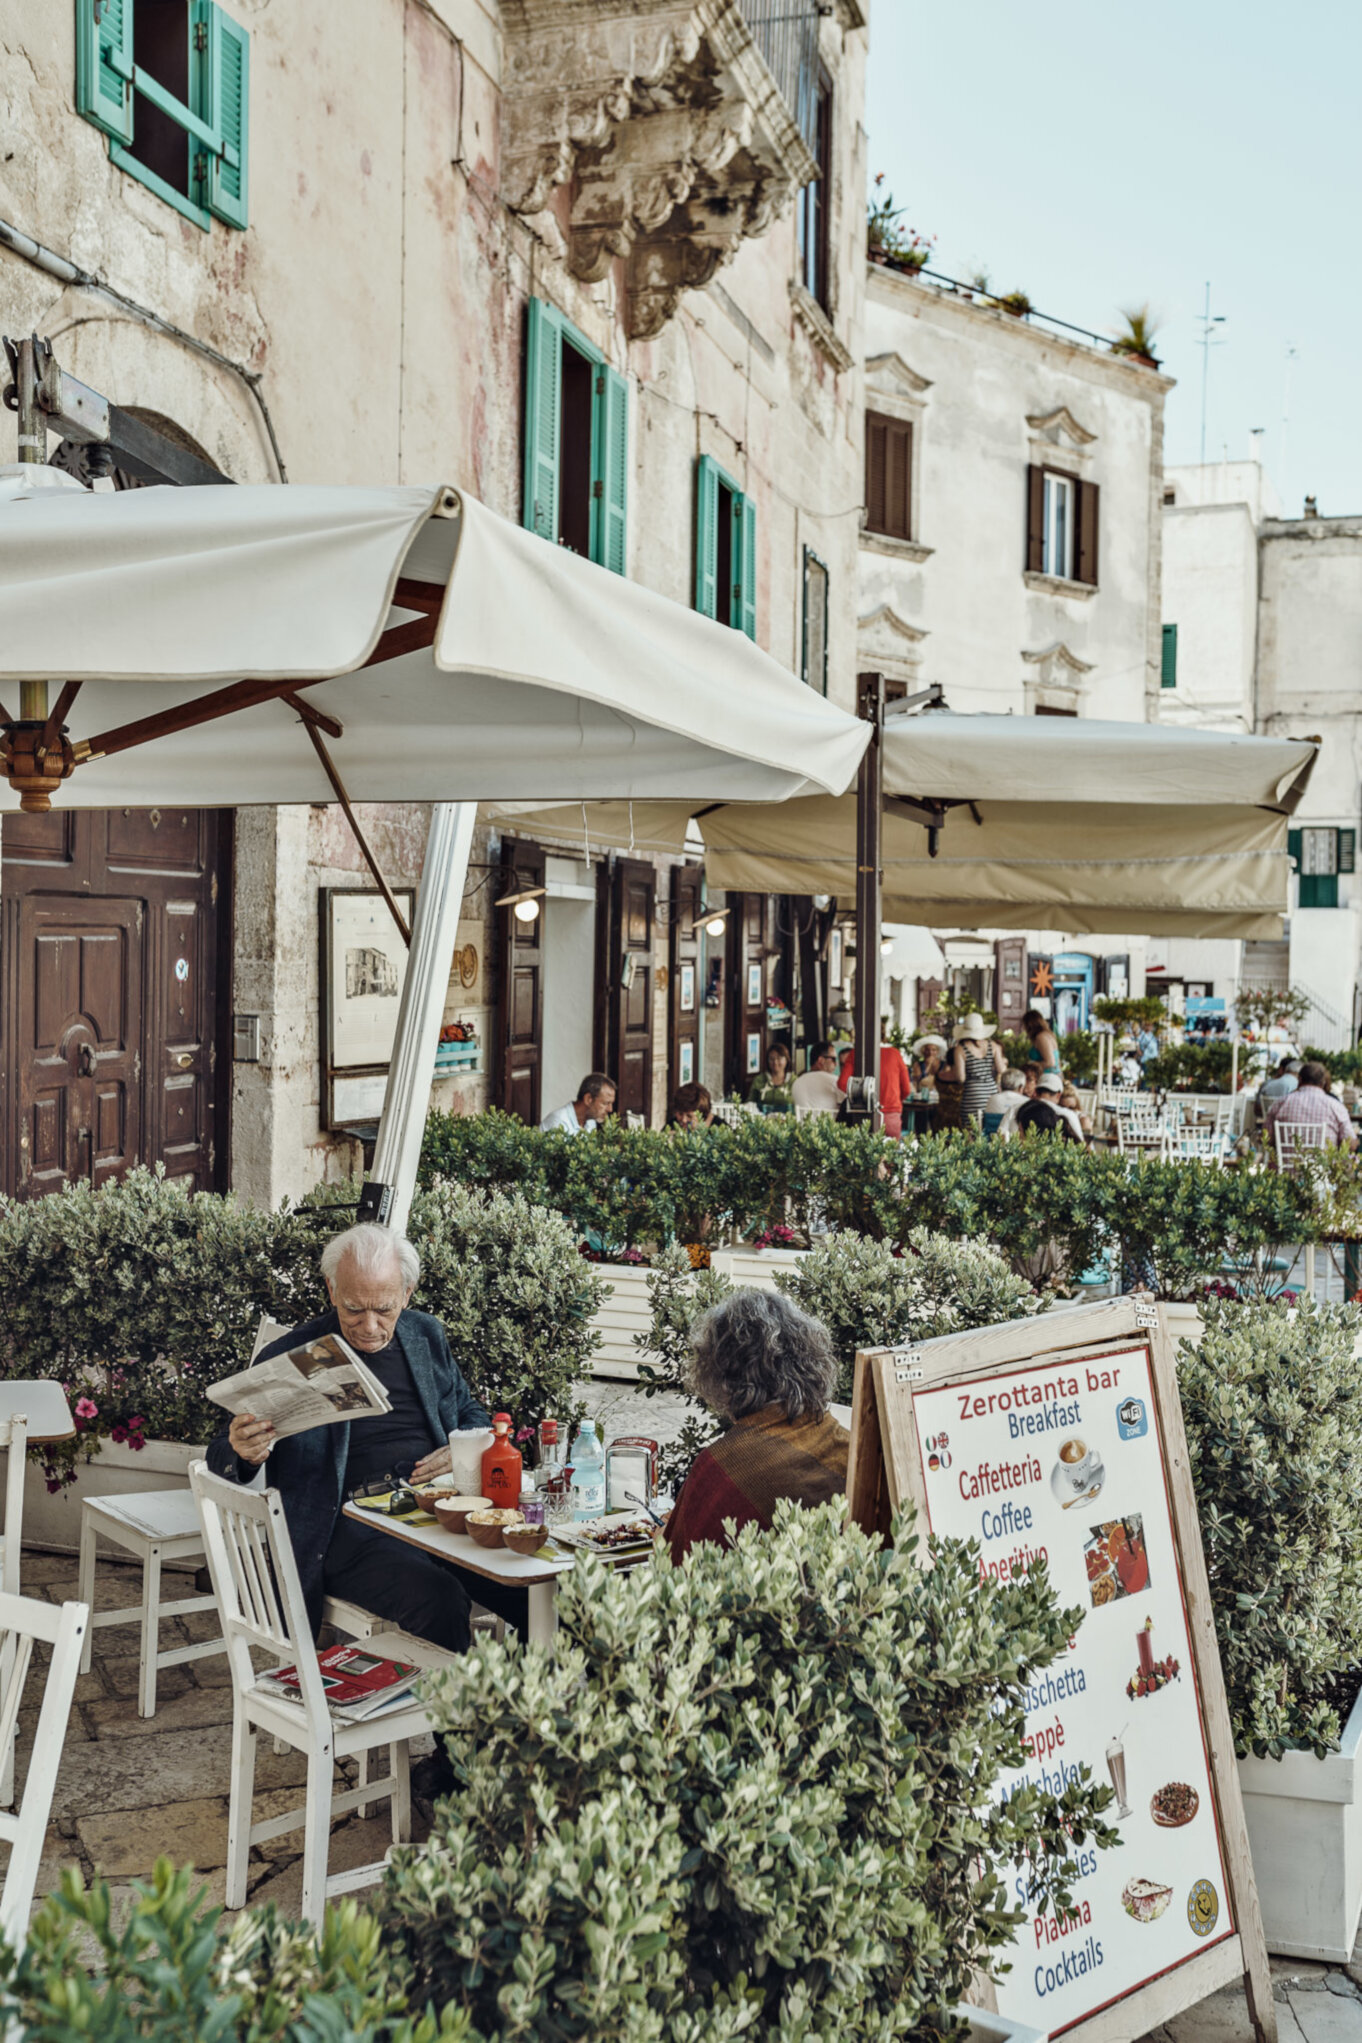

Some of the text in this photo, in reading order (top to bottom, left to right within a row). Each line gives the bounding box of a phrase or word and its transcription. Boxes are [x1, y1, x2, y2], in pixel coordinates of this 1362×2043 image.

[957, 1368, 1121, 1421] Zerottanta bar
[1008, 1400, 1083, 1440] Breakfast
[958, 1453, 1043, 1501] Caffetteria
[981, 1501, 1033, 1541] Coffee
[1020, 1714, 1066, 1763] rappè
[1016, 1849, 1097, 1908] Smies
[1034, 1935, 1104, 1998] Cocktails
